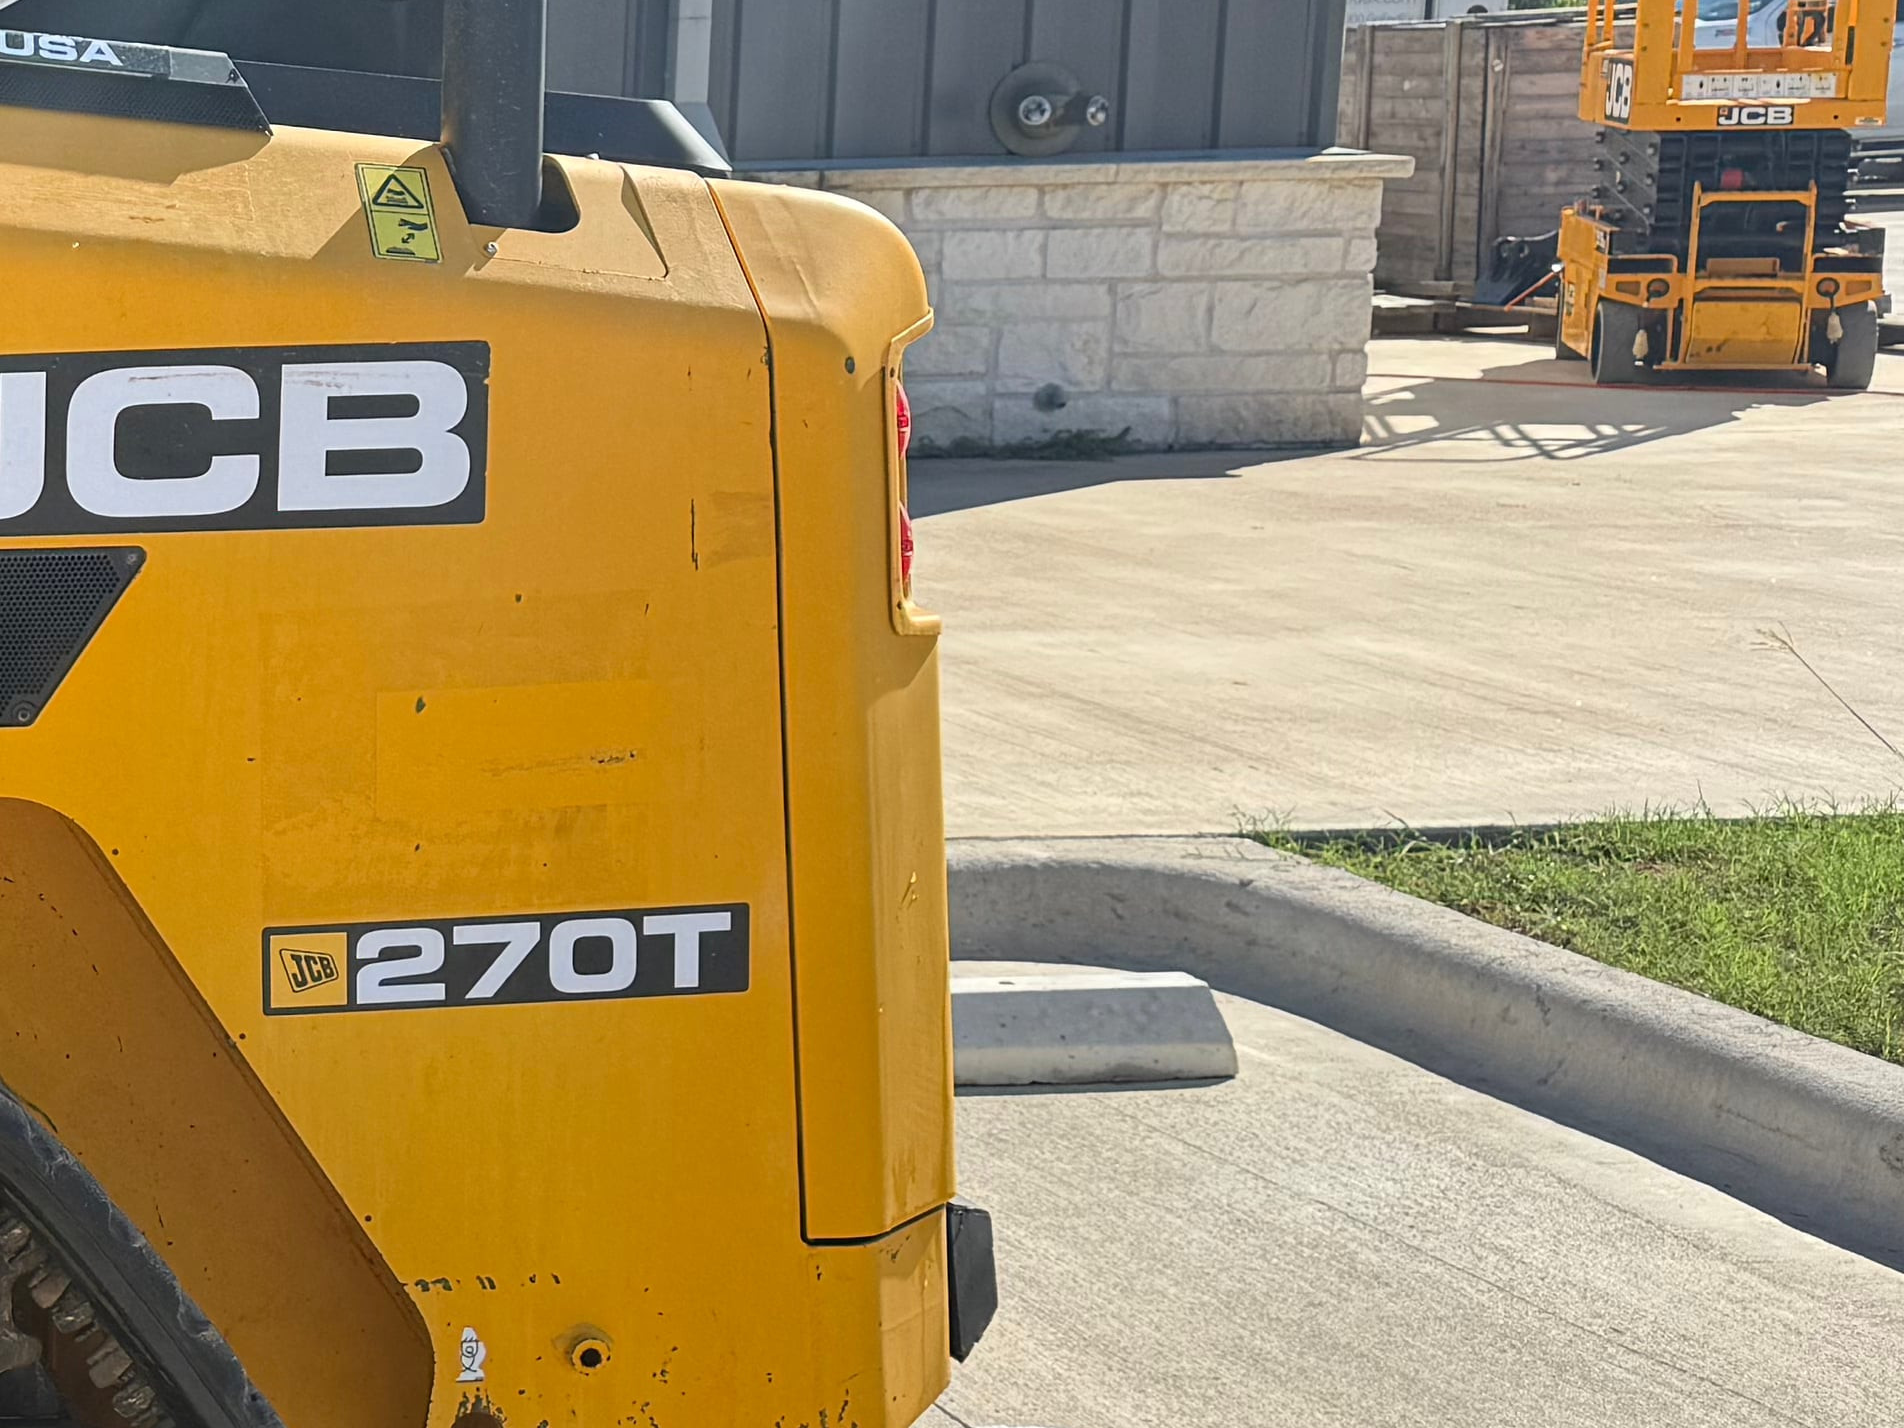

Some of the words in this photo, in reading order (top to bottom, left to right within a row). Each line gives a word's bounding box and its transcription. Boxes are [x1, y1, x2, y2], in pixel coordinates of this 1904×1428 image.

[1718, 106, 1793, 125] JCB
[290, 953, 334, 989] JCB
[356, 911, 733, 1005] 270T
